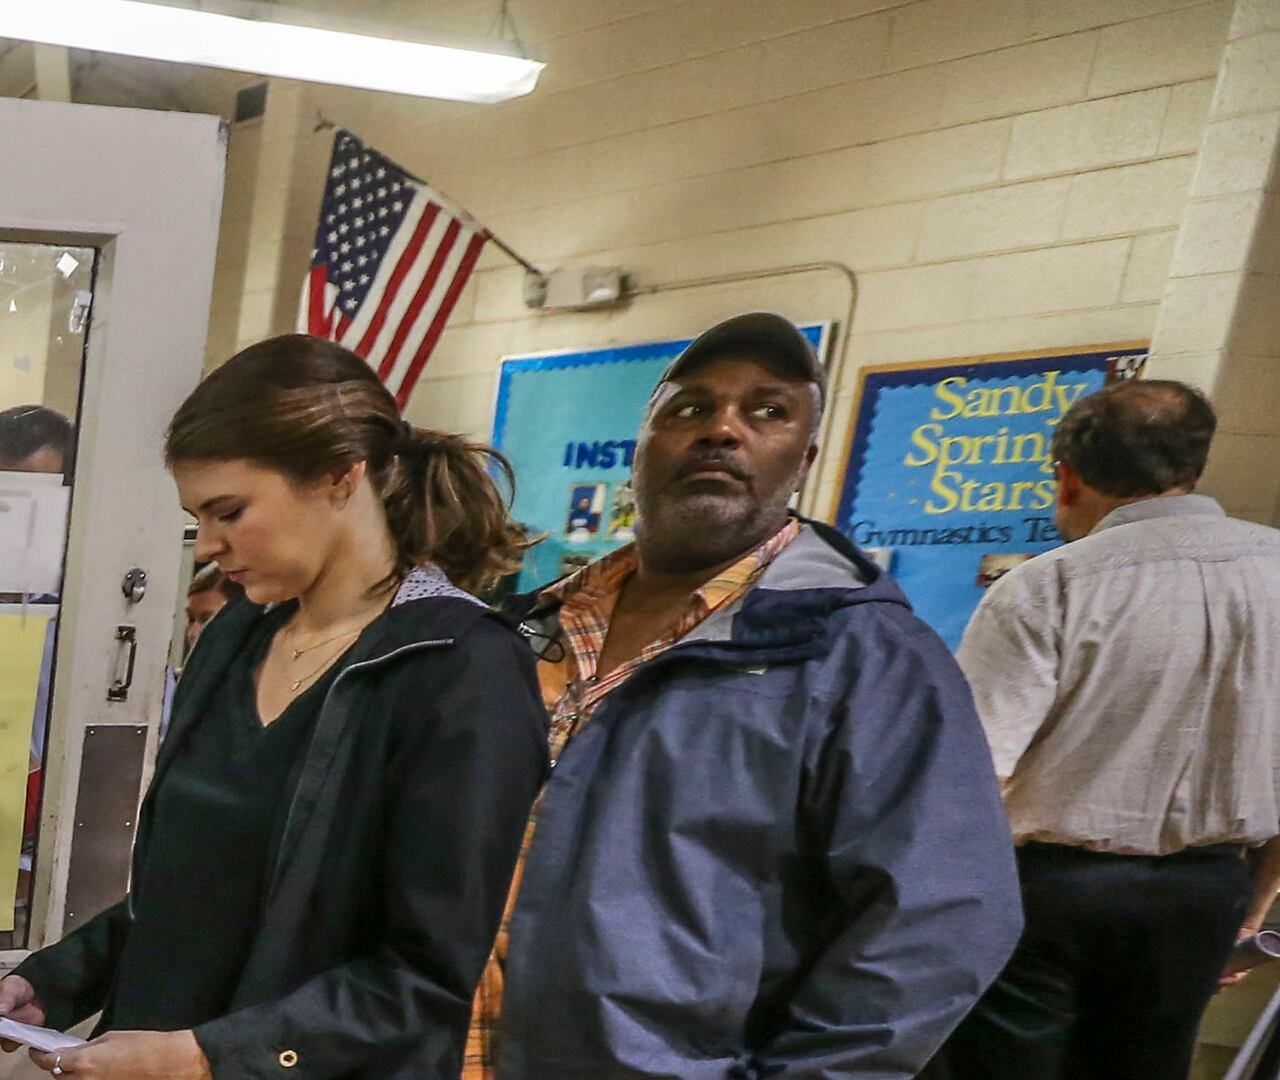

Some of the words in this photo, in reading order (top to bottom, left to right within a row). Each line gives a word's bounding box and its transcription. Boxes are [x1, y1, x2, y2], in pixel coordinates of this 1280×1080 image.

[930, 370, 1088, 426] Sandy
[563, 439, 637, 468] INST
[903, 424, 1060, 476] Sprin
[923, 471, 1058, 515] Stars
[850, 520, 1013, 547] Gymnastics
[1023, 517, 1058, 544] Te
